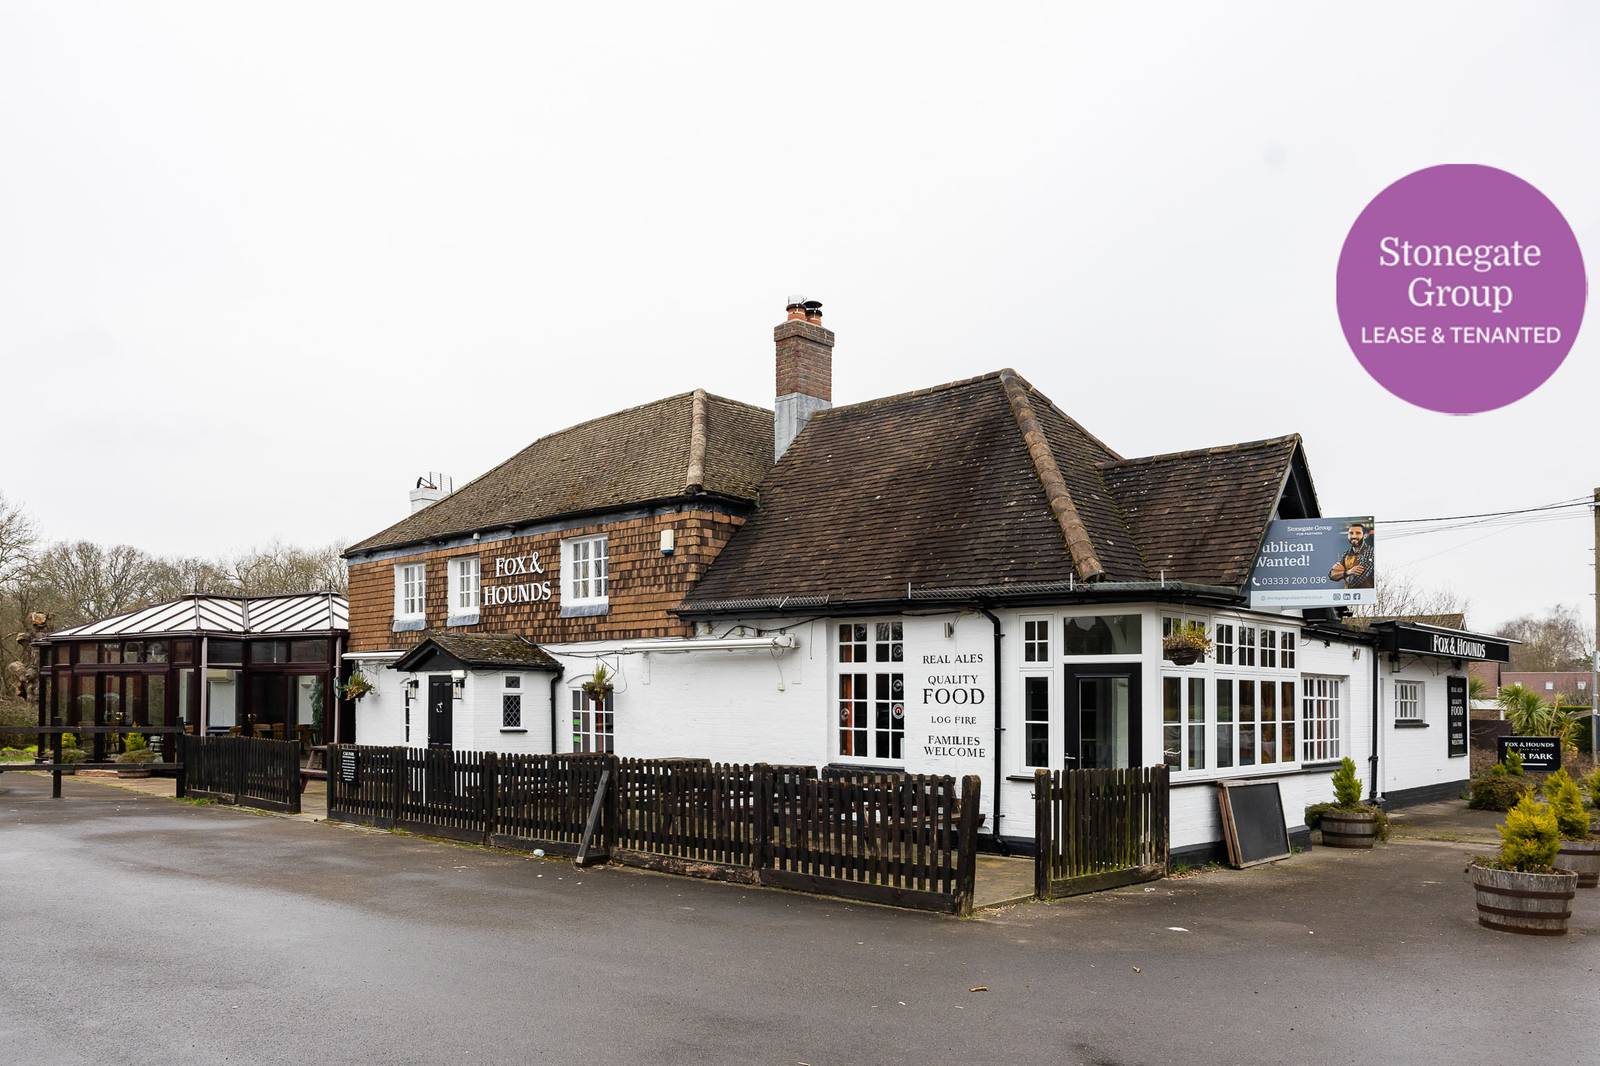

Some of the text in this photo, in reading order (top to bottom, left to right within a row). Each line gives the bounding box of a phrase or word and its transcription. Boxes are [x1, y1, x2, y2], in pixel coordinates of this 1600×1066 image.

[1262, 541, 1314, 553] ublican
[495, 551, 545, 577] FOX &
[1262, 577, 1289, 585] 03333
[1310, 576, 1327, 584] 036
[484, 581, 552, 606] HOUNDS
[1433, 634, 1449, 653] FOX
[1457, 638, 1486, 658] HOUNDS
[922, 653, 984, 664] REAL ALES
[927, 675, 979, 685] QUALITY
[923, 688, 985, 704] FOOD
[931, 716, 977, 725] LOG FIRE
[928, 735, 981, 746] FAMILIES
[924, 746, 986, 758] WELCOME
